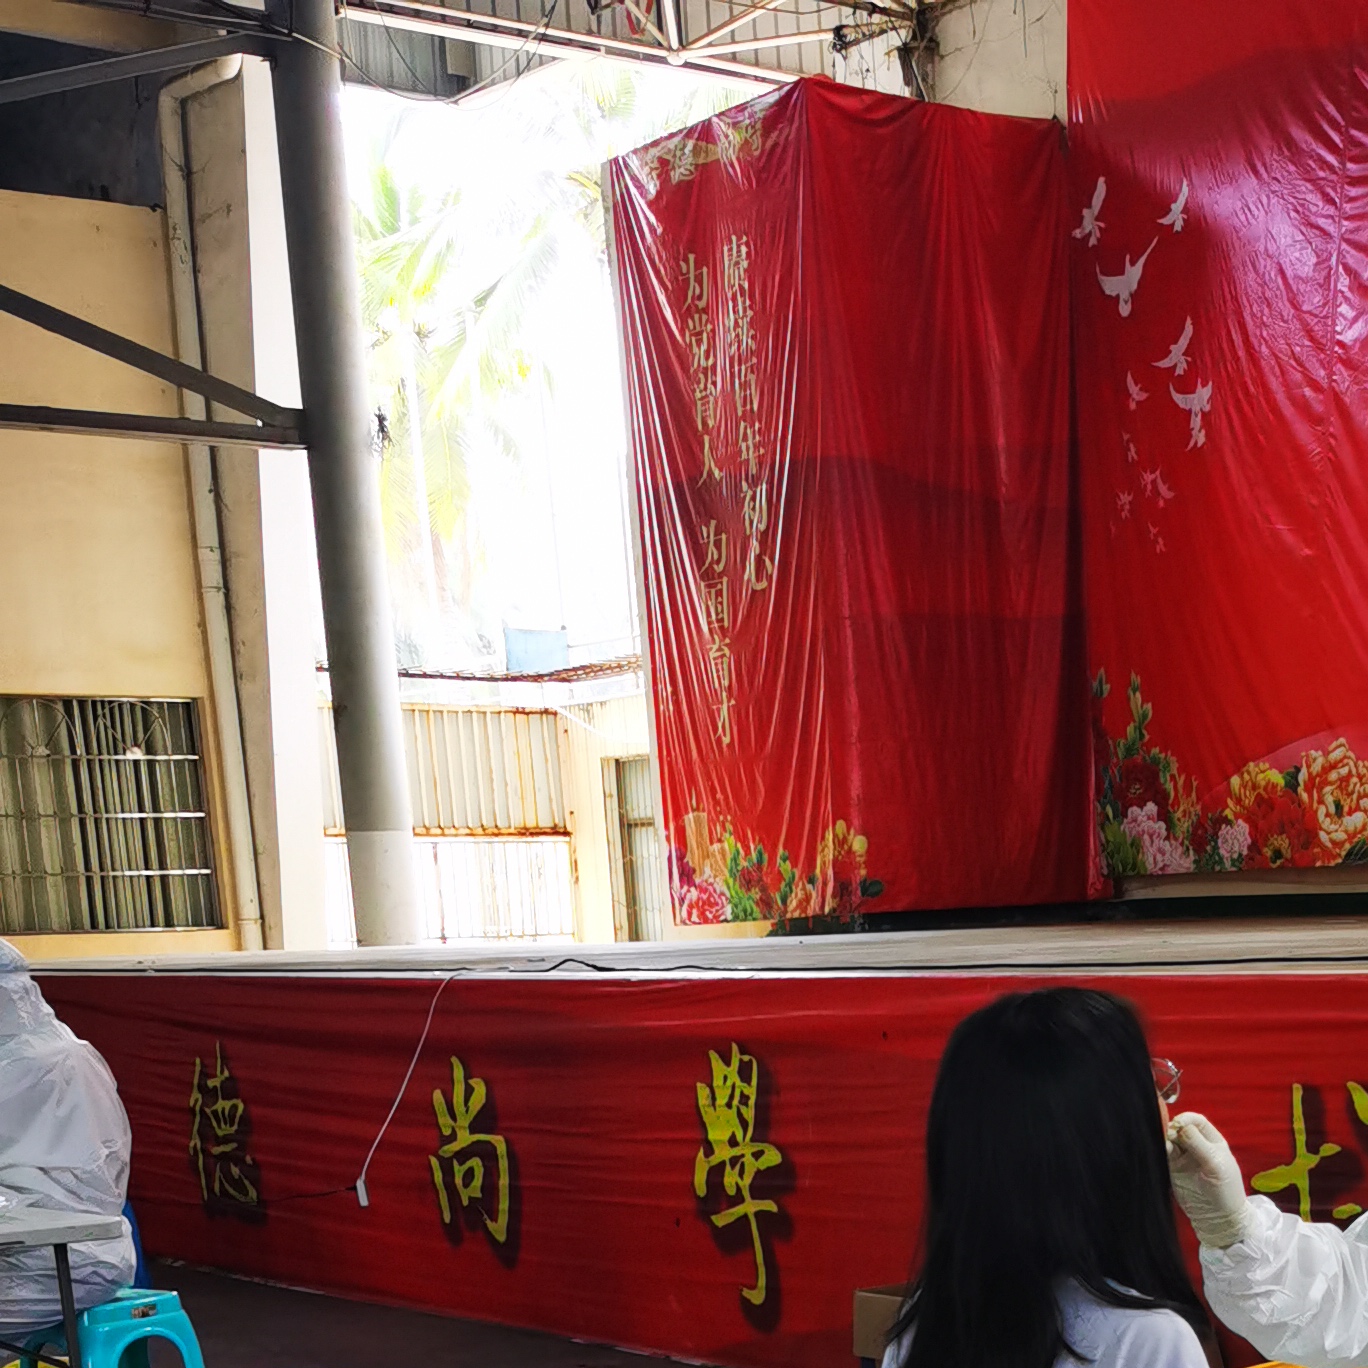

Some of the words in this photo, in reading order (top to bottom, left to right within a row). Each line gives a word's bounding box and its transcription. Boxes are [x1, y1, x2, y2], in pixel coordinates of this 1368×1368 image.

[679, 254, 724, 488] 为党育人
[698, 519, 737, 745] 为国育才
